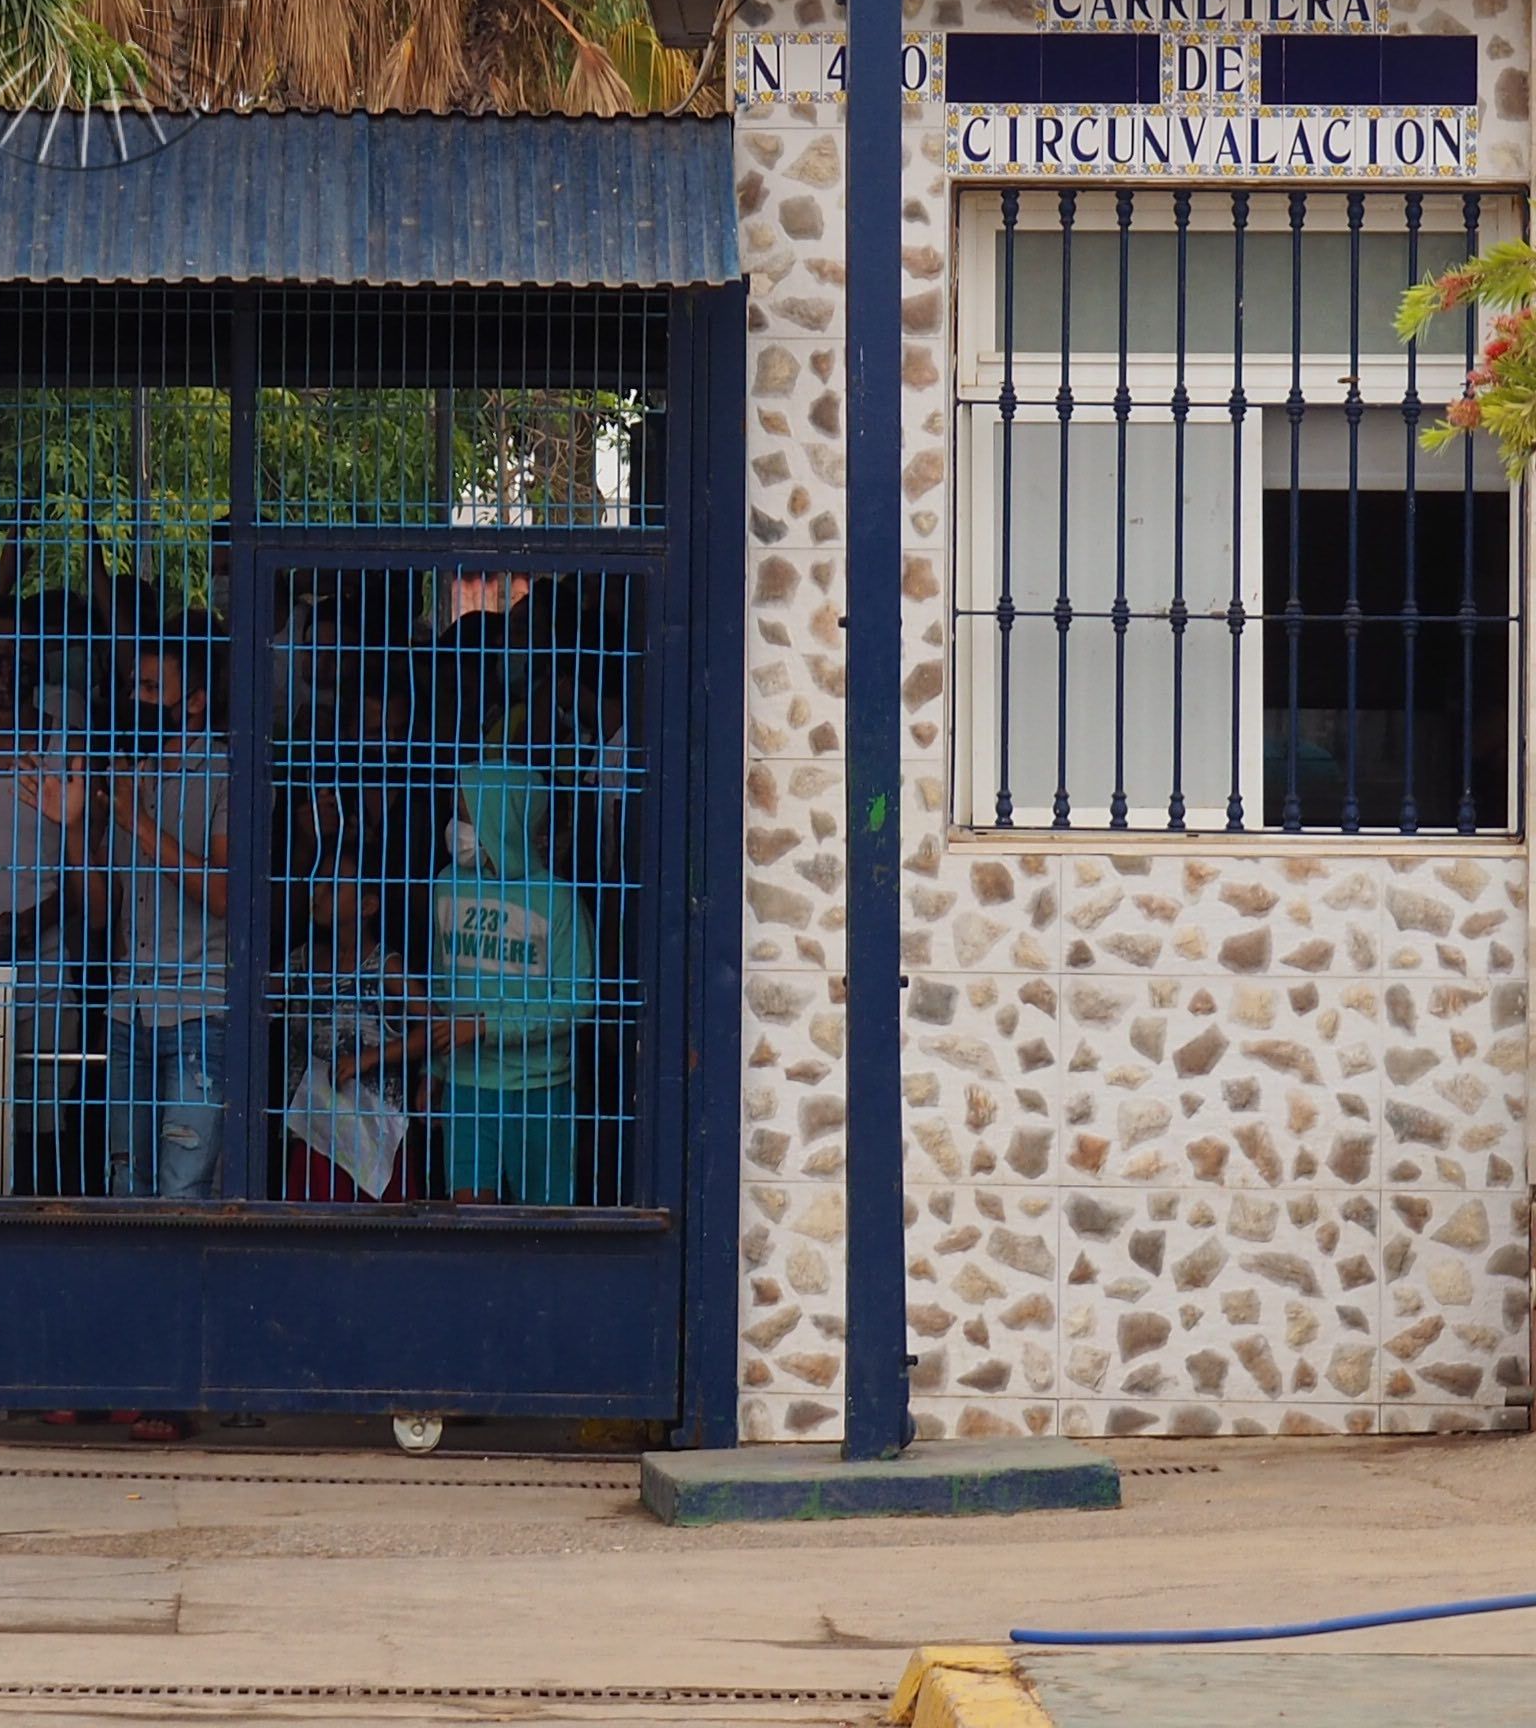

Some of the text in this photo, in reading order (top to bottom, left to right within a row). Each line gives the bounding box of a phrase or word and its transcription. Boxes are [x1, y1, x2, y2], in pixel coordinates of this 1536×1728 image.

[751, 44, 928, 92] N 40
[1179, 45, 1244, 92] DE
[961, 116, 1463, 165] CIRCUNVALACION
